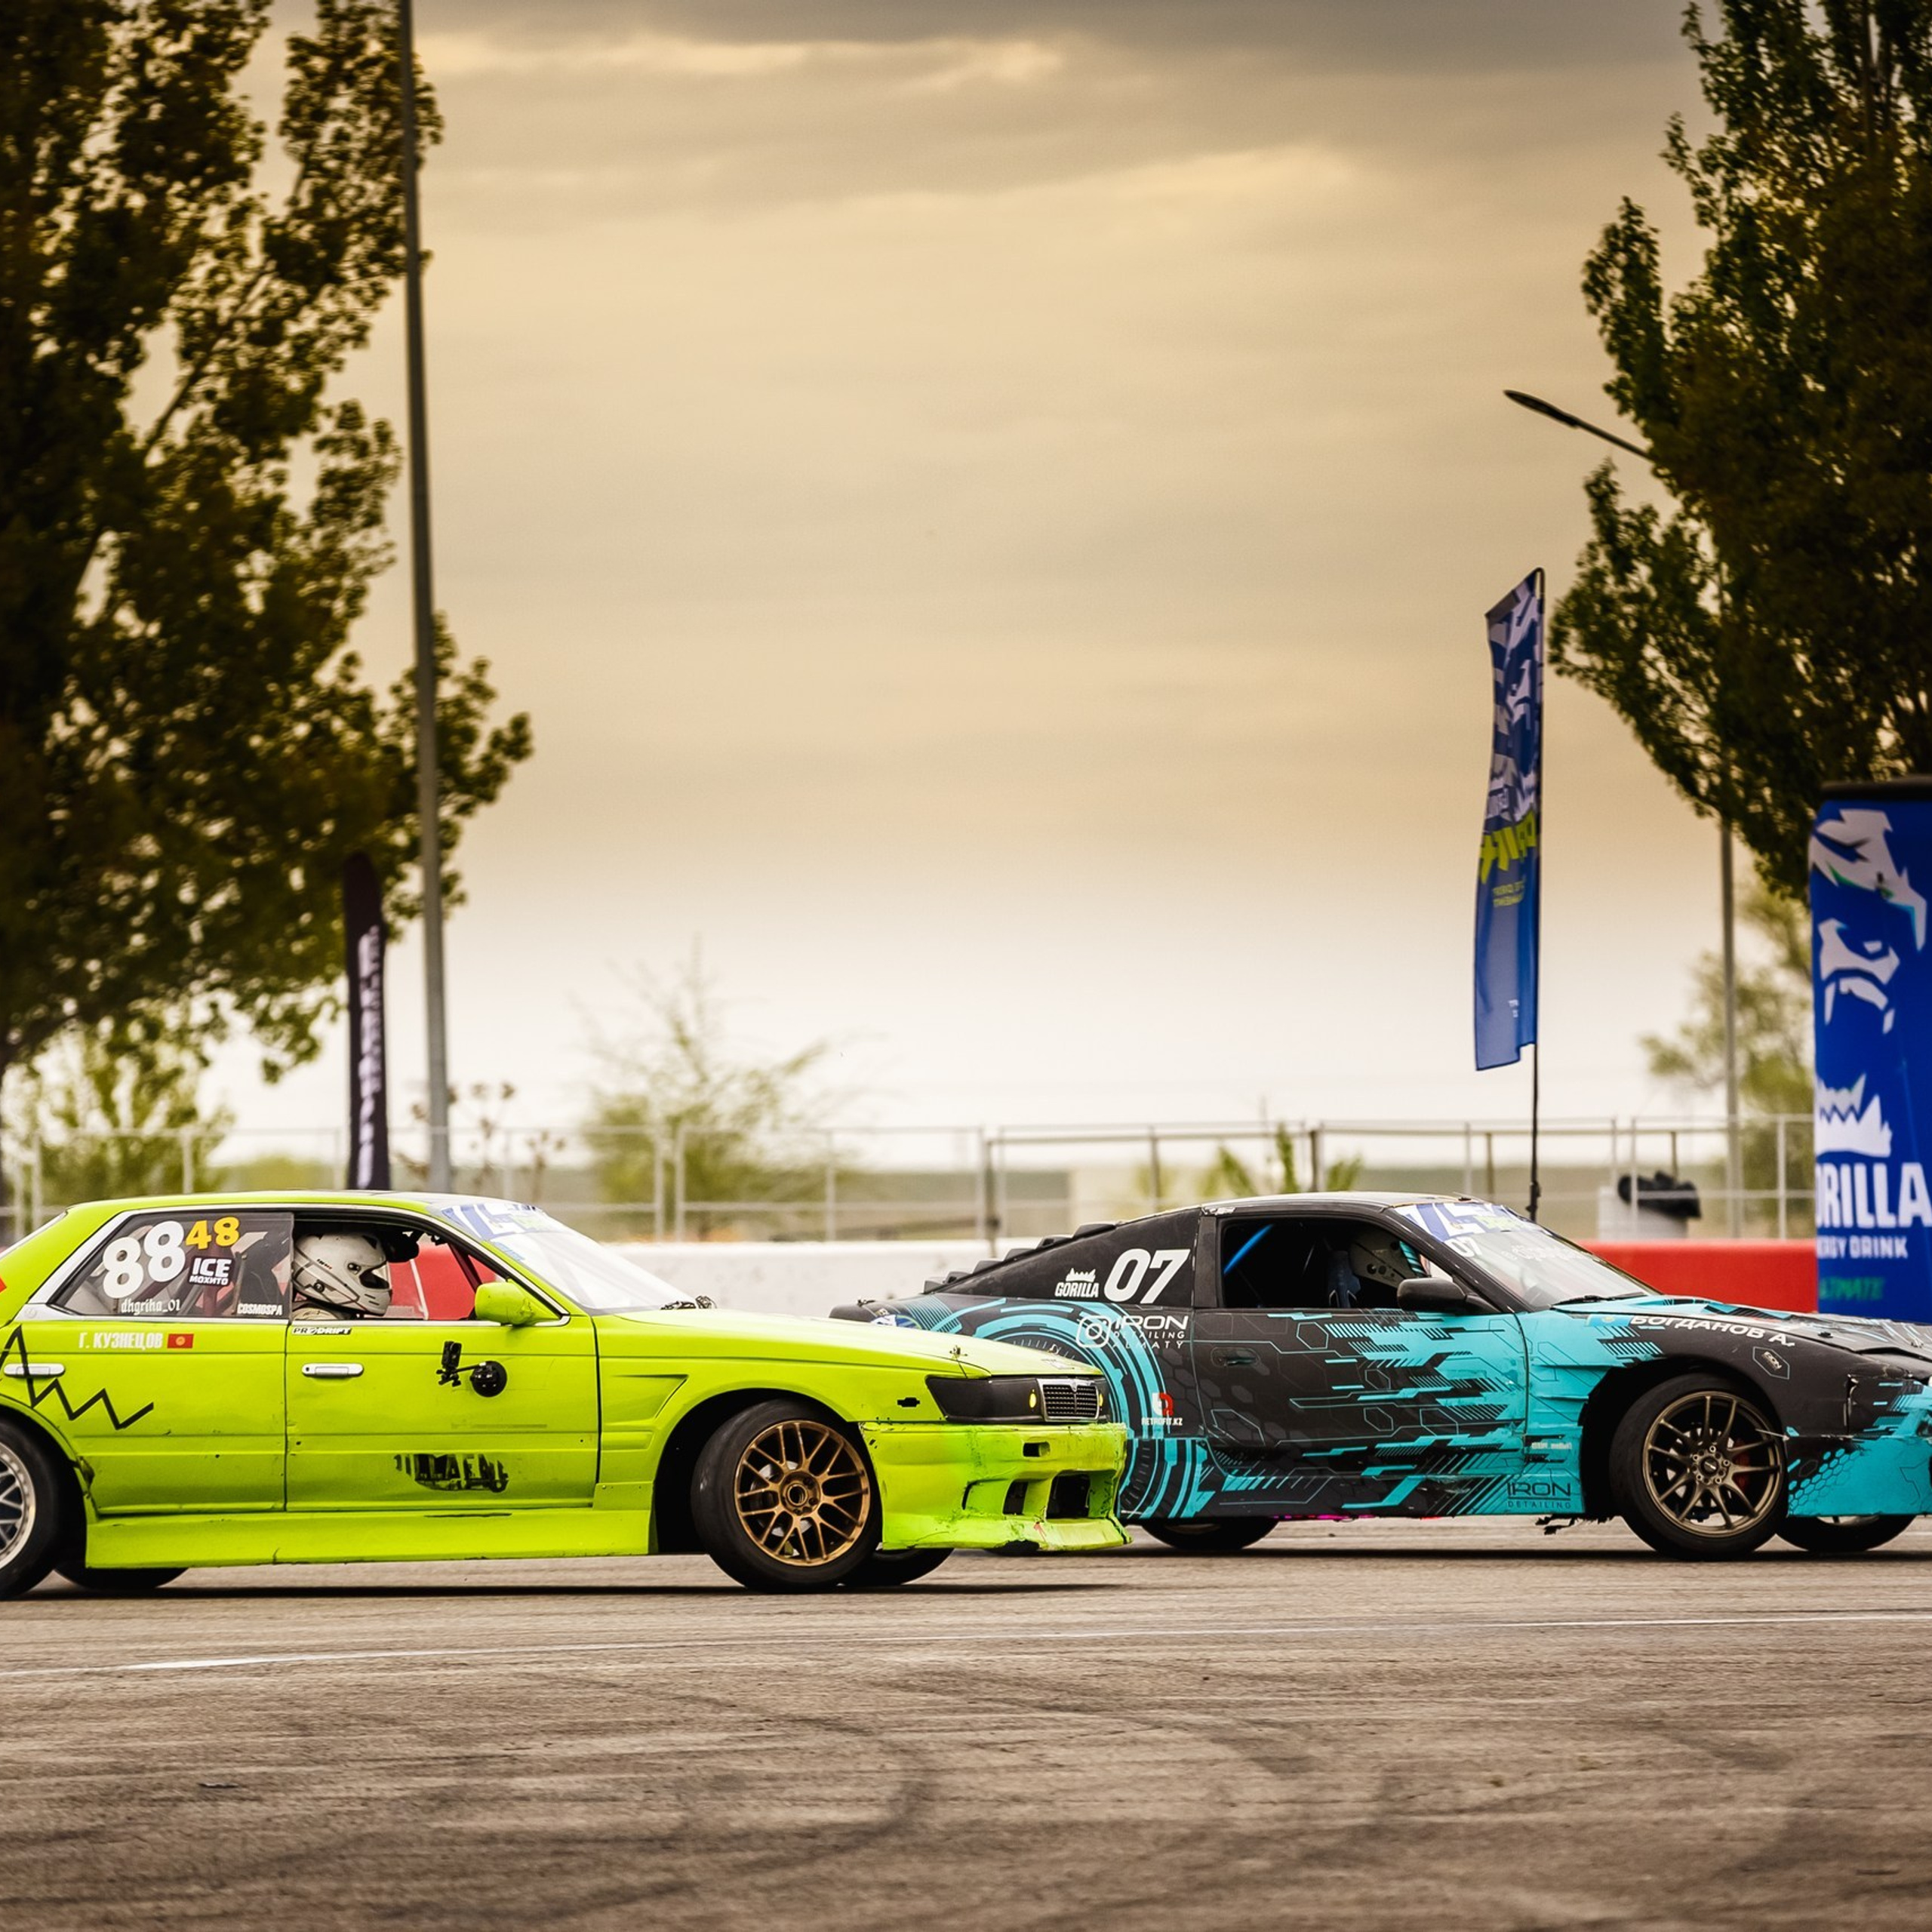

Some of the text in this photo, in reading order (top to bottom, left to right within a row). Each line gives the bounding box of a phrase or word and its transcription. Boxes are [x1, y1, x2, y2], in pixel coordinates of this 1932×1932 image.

[186, 1217, 240, 1250] 48
[1849, 1235, 1909, 1259] DRINK
[103, 1220, 186, 1299] 88
[192, 1257, 232, 1277] ICE
[189, 1275, 229, 1285] МОХИТО
[1103, 1248, 1191, 1304] 07
[1054, 1282, 1100, 1298] GORILLA
[237, 1303, 283, 1316] COSMOSPA
[1114, 1315, 1189, 1330] IRON
[1630, 1315, 1764, 1339] БОГДАНОВ
[78, 1331, 163, 1351] Г. КУЗНЕЦОВ
[1507, 1482, 1571, 1497] IRON
